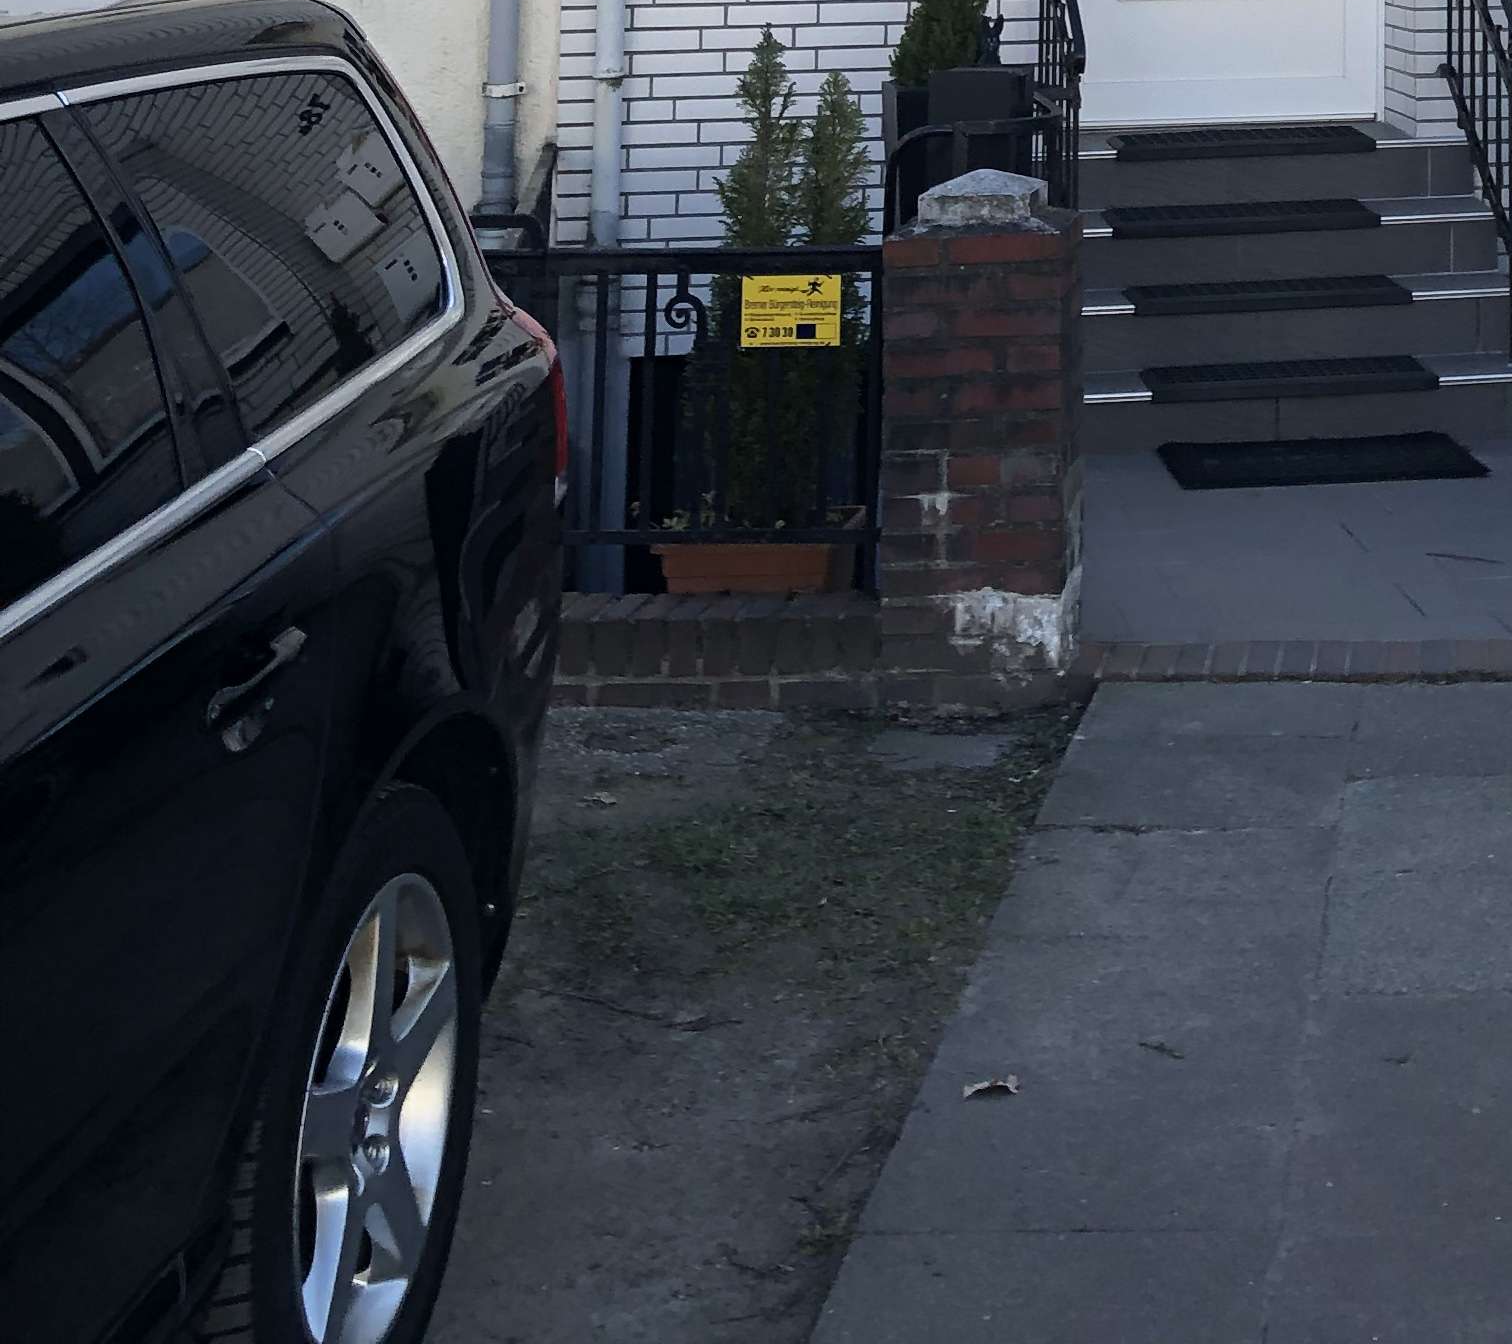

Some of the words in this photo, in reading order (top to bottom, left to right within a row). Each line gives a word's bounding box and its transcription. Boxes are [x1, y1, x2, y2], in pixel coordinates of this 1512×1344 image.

[762, 327, 767, 338] 7
[769, 327, 781, 338] 30
[782, 327, 794, 338] 30
